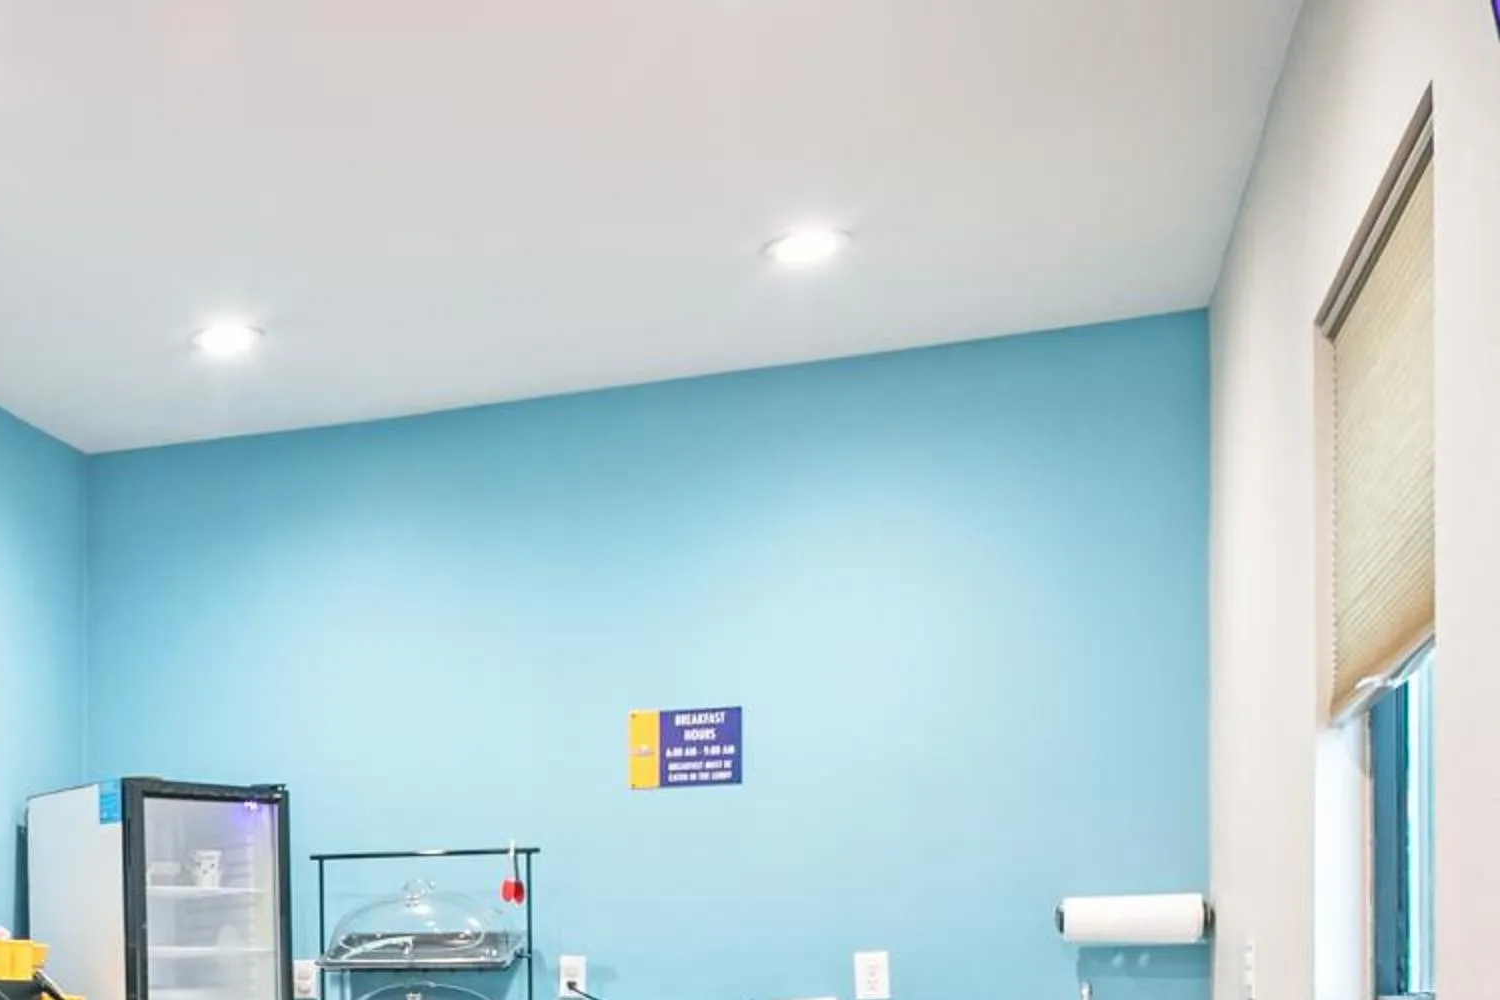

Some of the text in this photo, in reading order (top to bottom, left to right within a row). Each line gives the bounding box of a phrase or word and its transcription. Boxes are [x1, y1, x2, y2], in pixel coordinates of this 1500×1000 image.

[675, 711, 725, 727] BREAKFAST
[684, 728, 717, 741] HOURS
[684, 746, 697, 757] AM
[722, 744, 735, 756] AM
